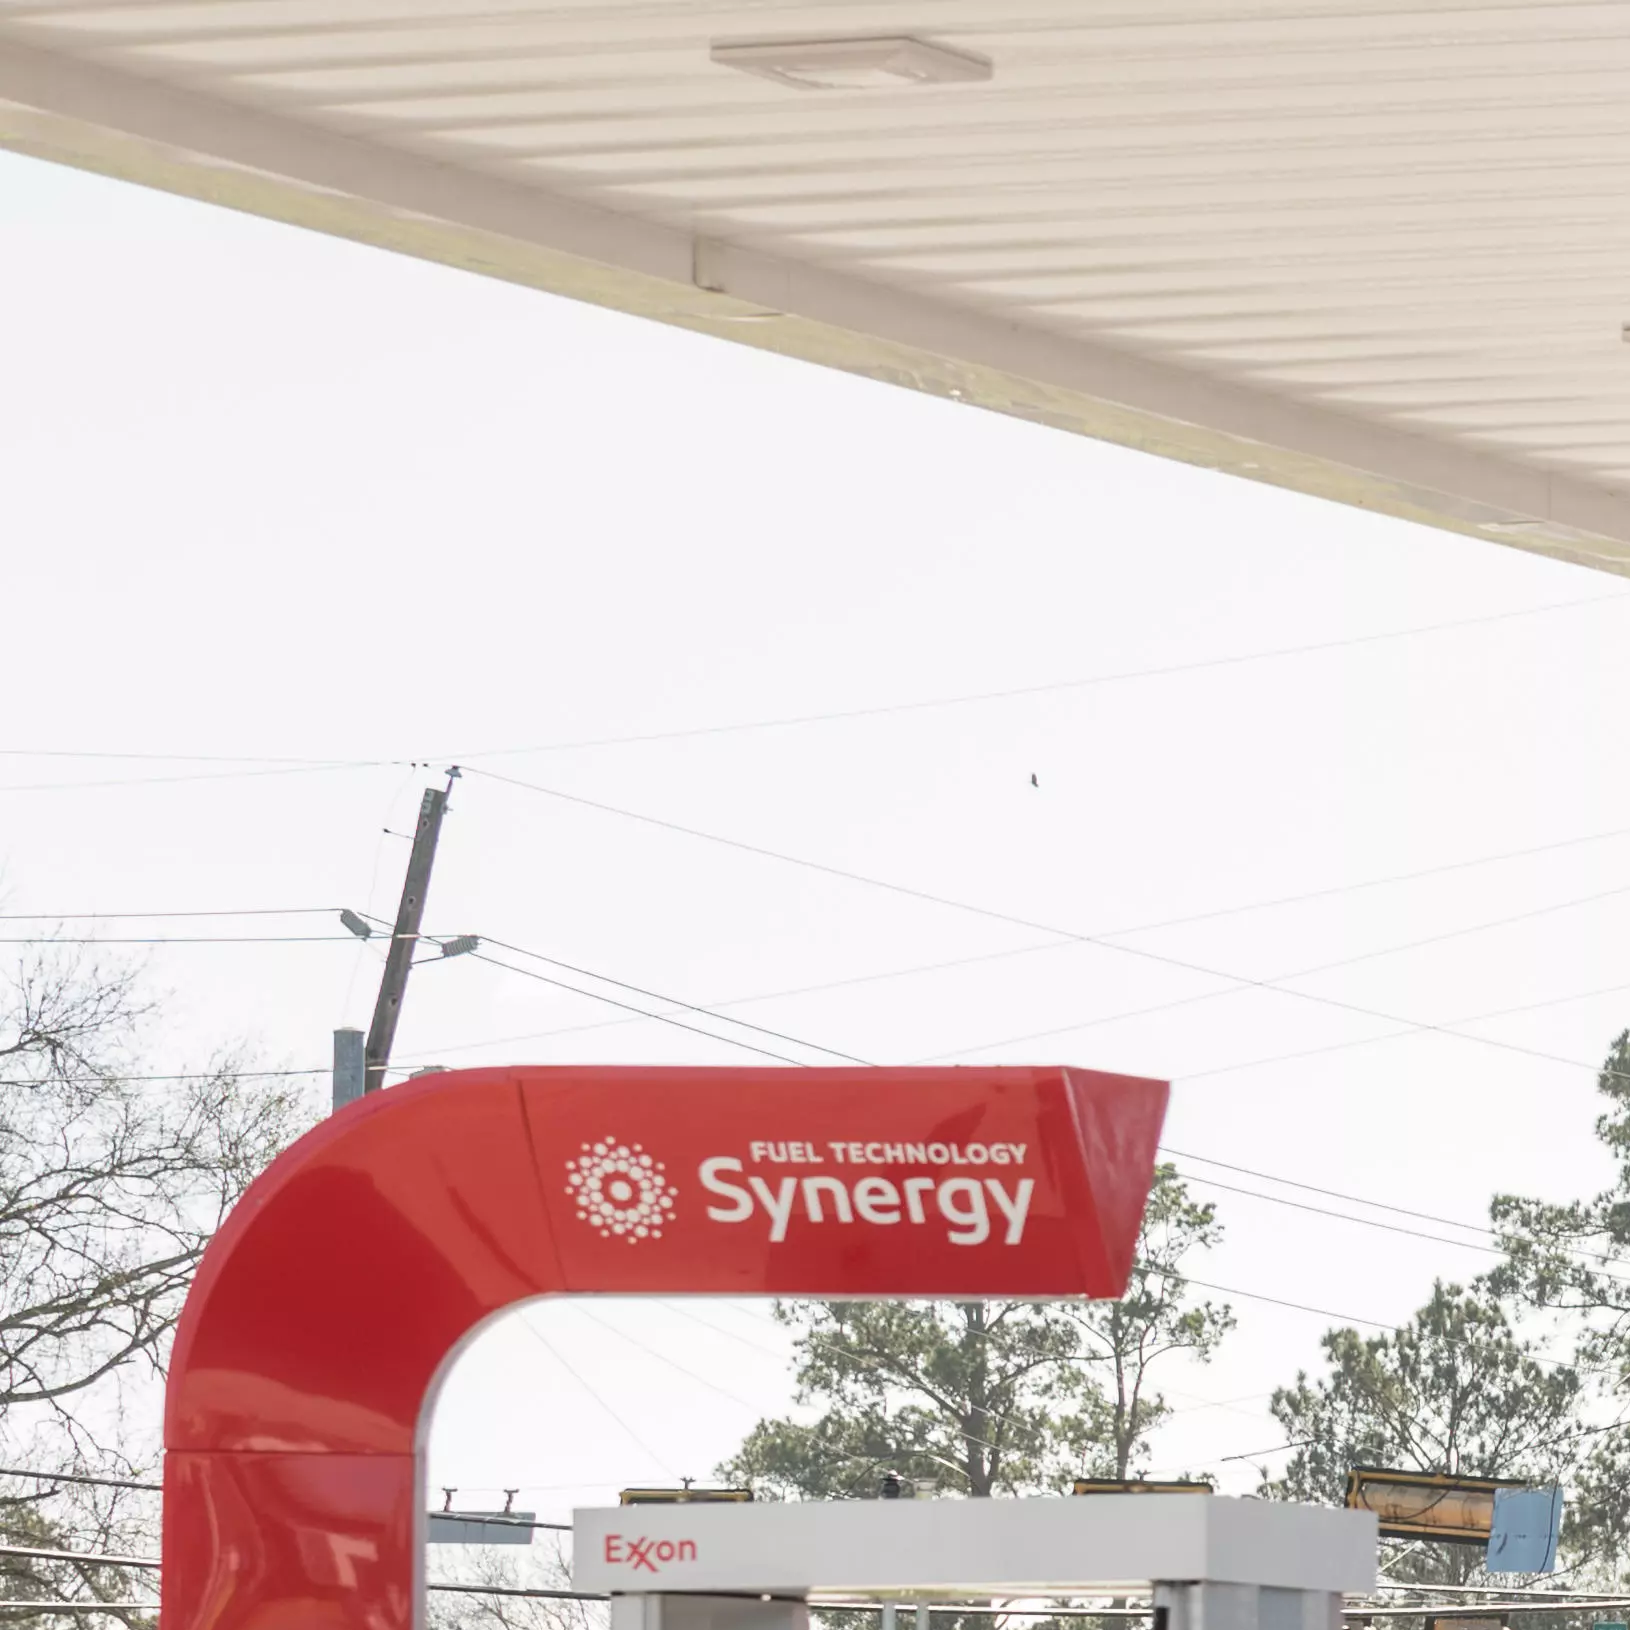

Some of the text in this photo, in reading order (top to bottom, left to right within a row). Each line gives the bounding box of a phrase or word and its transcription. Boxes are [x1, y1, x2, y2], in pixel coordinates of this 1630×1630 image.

[750, 1141, 1027, 1165] FUEL TECHNOLOGY
[699, 1157, 1034, 1245] Synergy
[604, 1535, 697, 1573] Exxon
